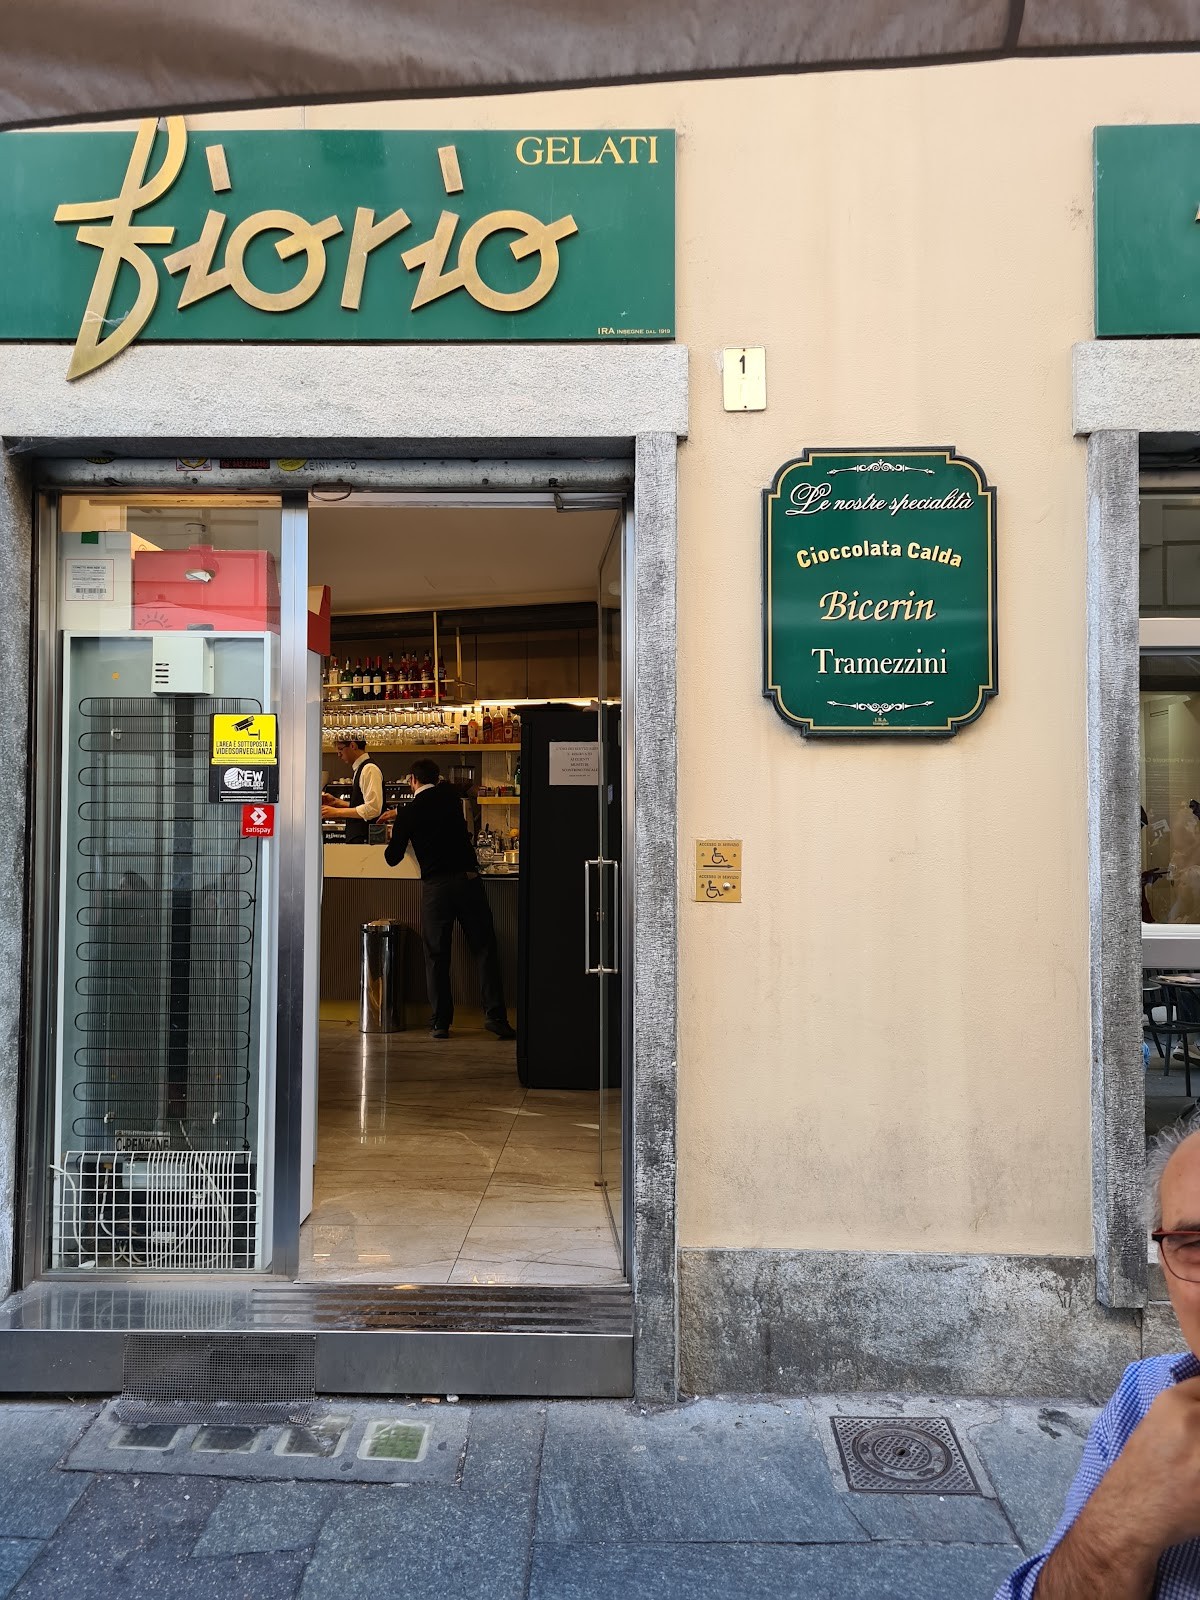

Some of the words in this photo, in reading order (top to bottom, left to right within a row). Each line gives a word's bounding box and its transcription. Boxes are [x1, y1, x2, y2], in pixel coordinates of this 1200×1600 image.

[516, 135, 658, 165] GELATI
[597, 327, 615, 335] IRA
[739, 355, 745, 374] 1
[785, 482, 832, 516] Le
[833, 493, 888, 510] nostre
[888, 488, 974, 516] specialità
[796, 540, 902, 568] Cioccolata
[907, 542, 963, 567] Calda
[819, 590, 937, 621] Bicerin
[811, 648, 948, 674] Tramezzini
[237, 770, 264, 781] NEW
